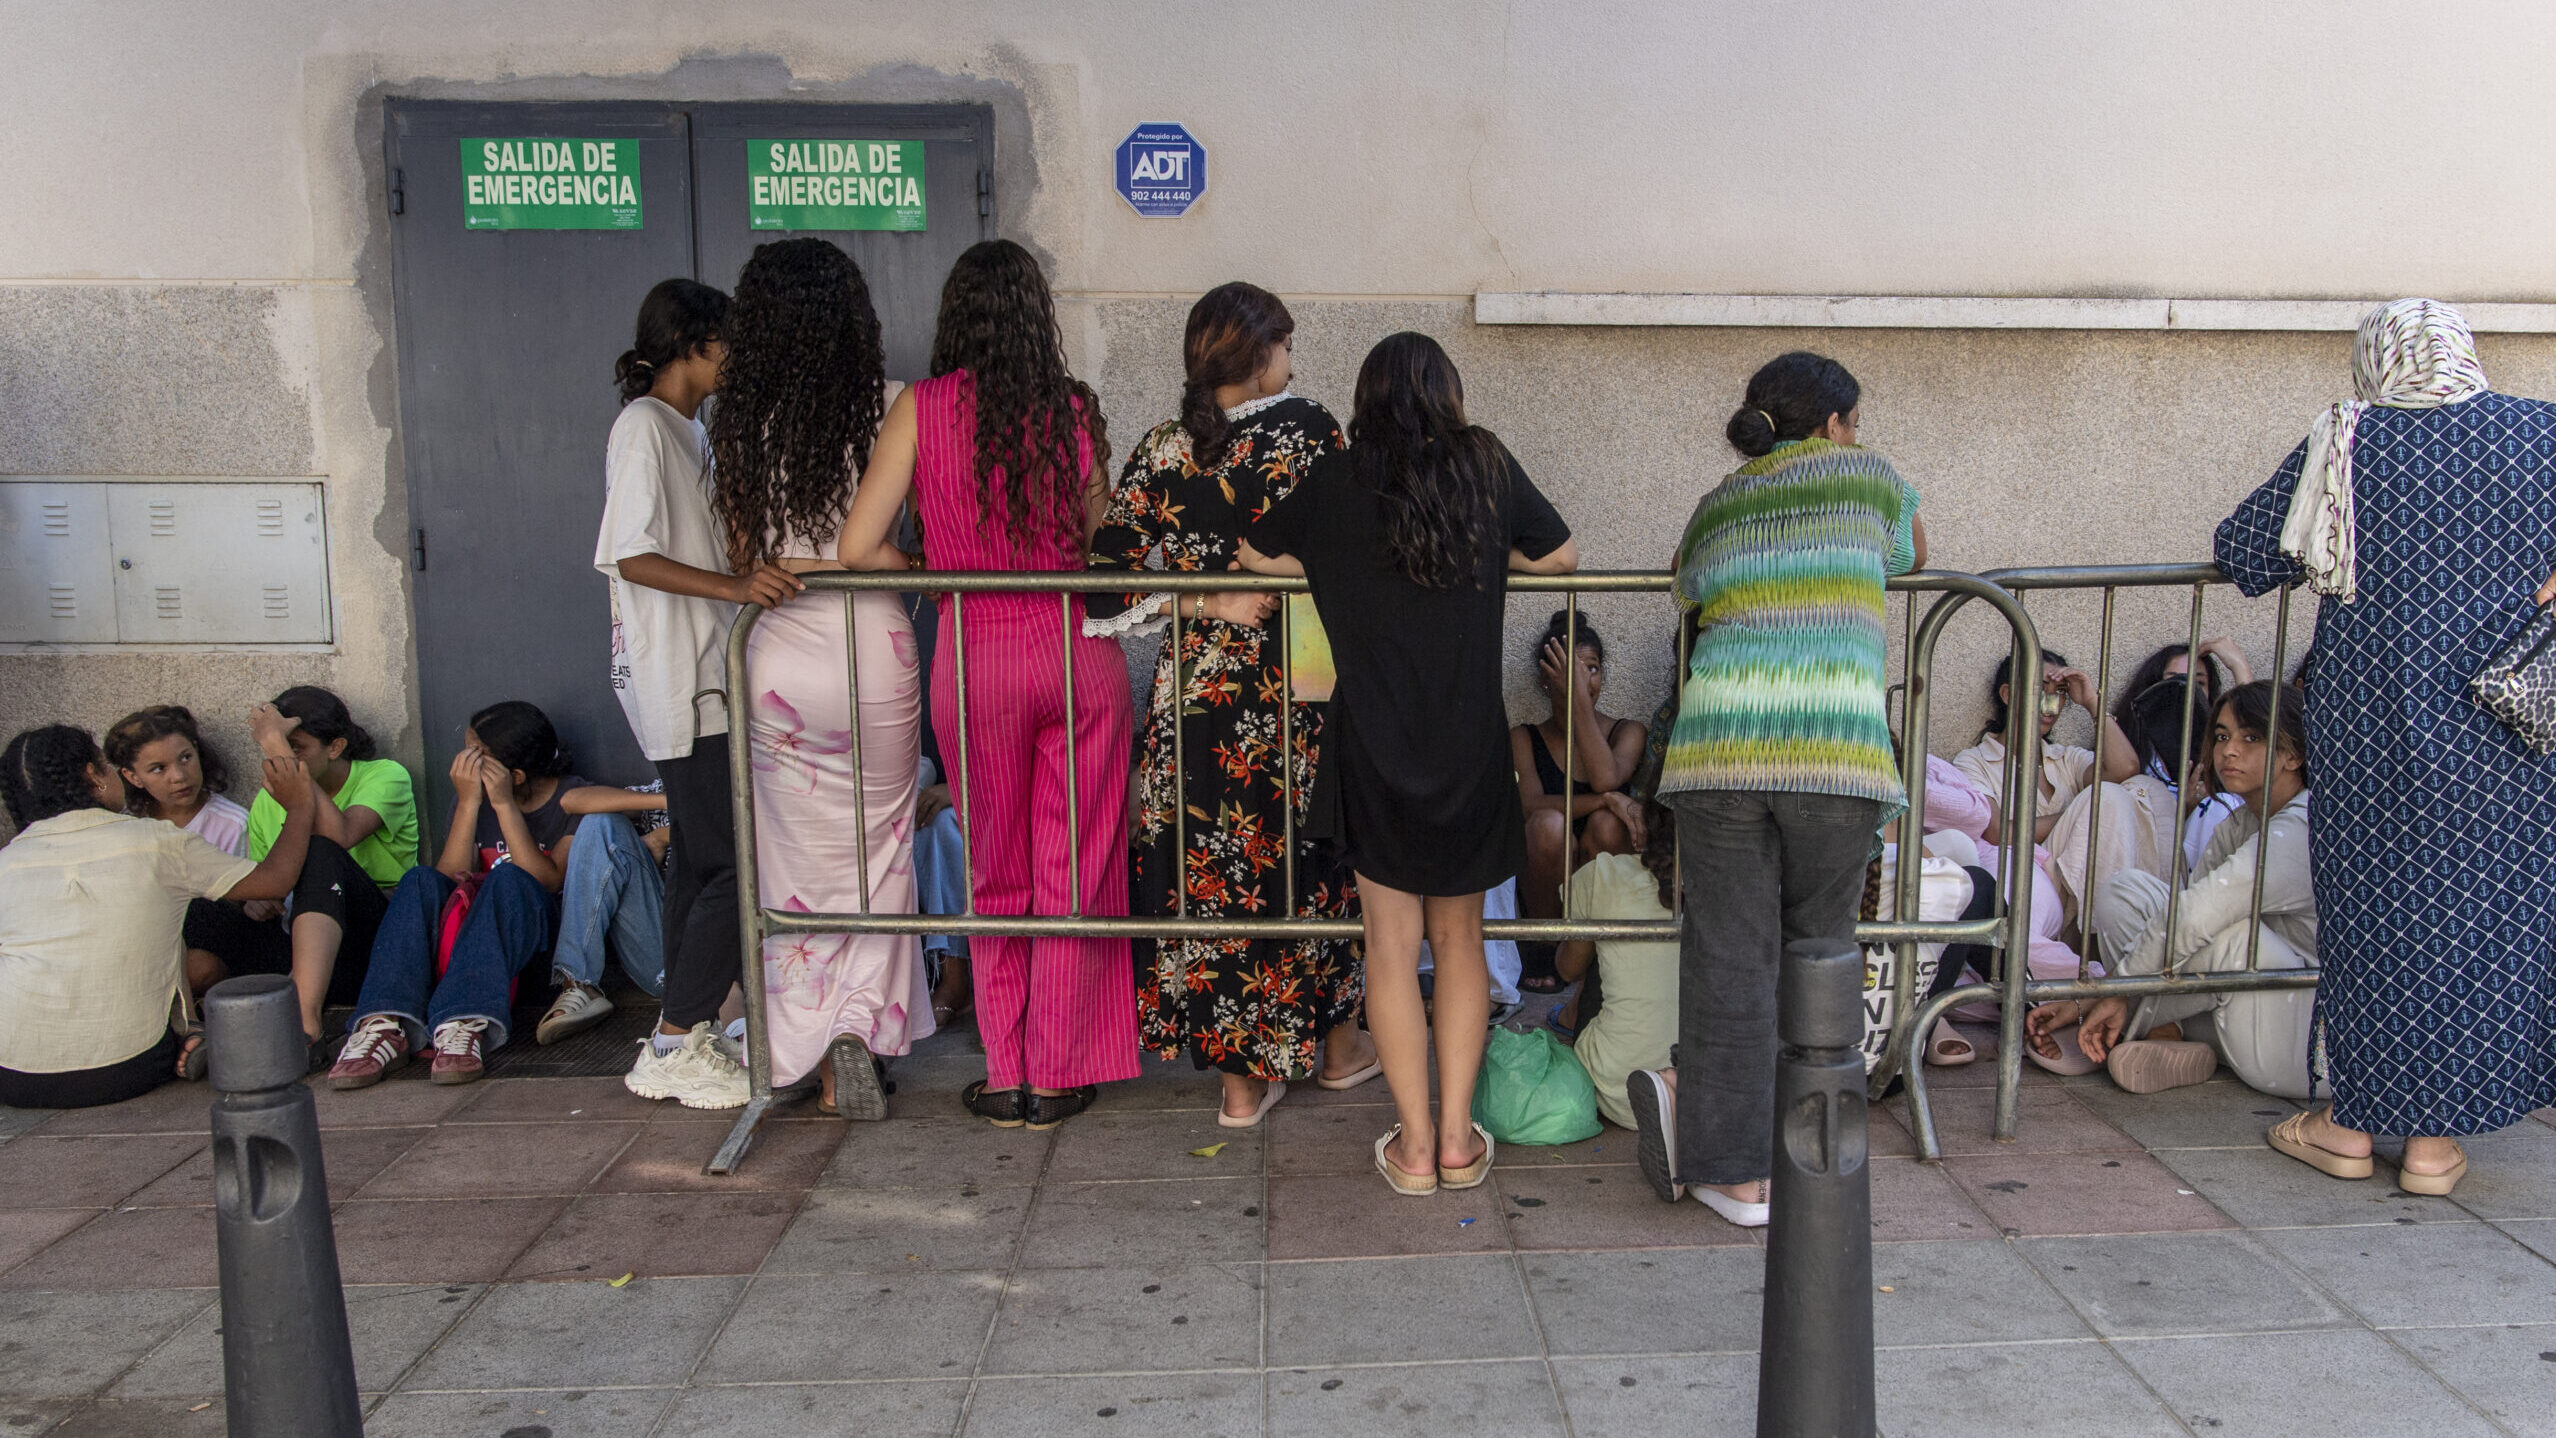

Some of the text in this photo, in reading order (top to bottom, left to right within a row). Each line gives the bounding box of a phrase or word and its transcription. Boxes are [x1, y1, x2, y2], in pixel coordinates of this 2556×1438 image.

[1137, 132, 1170, 141] Protegido
[483, 141, 617, 172] SALIDA DE
[770, 142, 902, 173] SALIDA DE
[1131, 151, 1190, 180] ADT
[467, 175, 637, 205] EMERGENCIA
[753, 176, 921, 206] EMERGENCIA
[1131, 191, 1191, 200] 902 444 440
